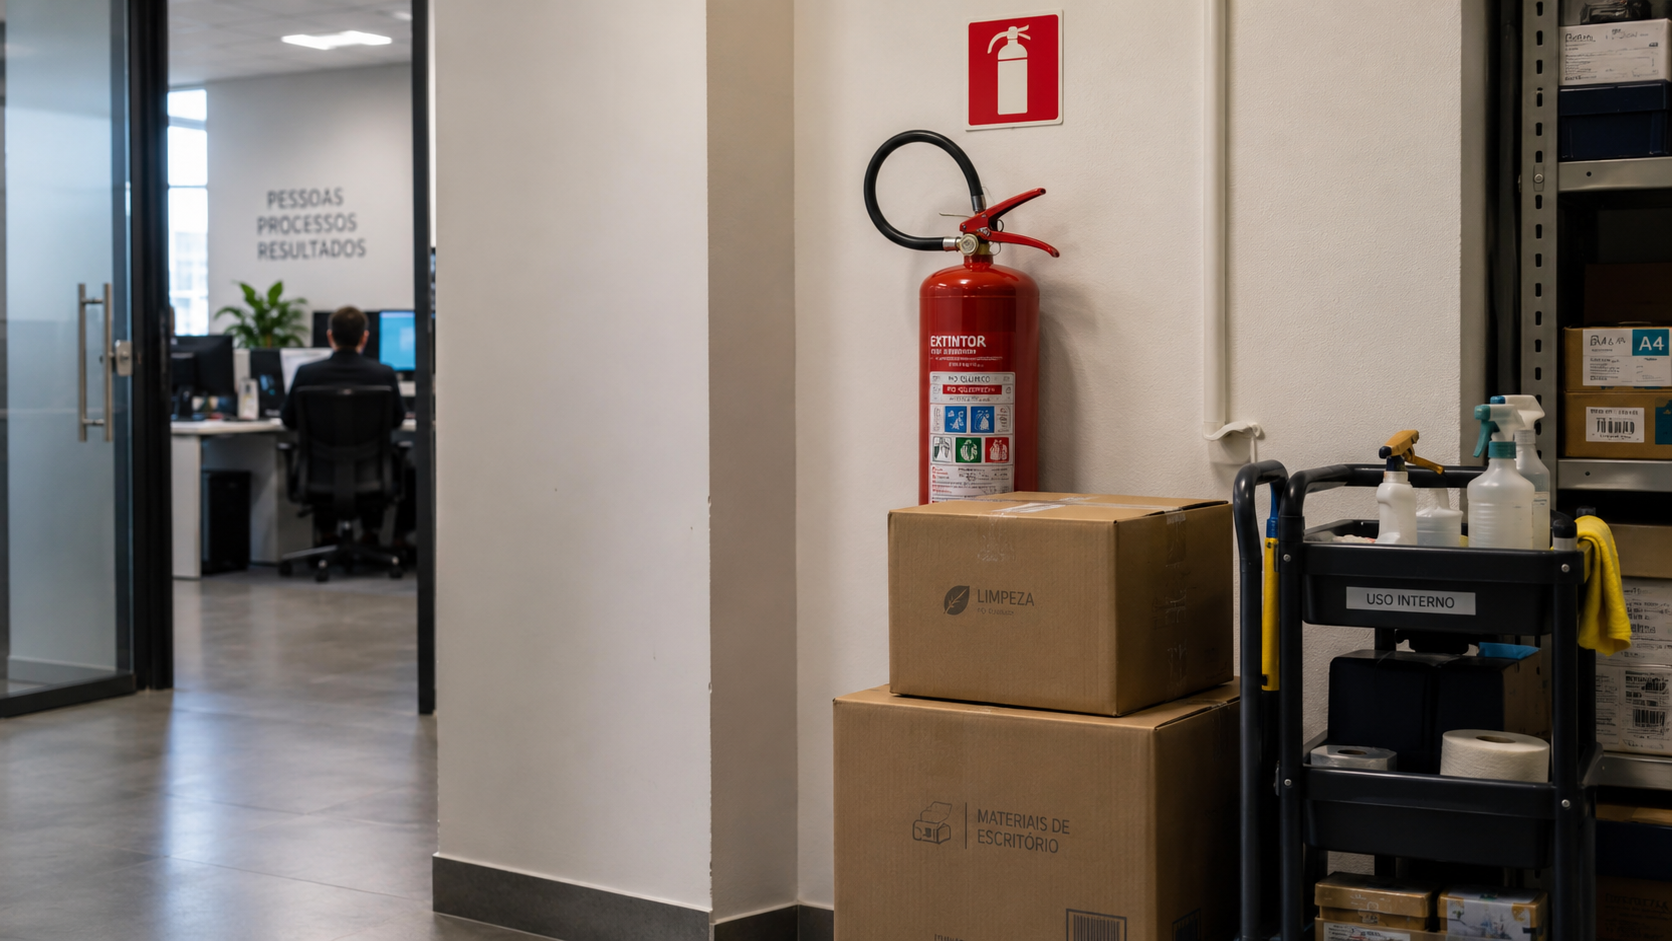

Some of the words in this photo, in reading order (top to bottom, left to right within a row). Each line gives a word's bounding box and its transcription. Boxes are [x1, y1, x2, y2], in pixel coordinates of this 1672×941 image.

[267, 187, 344, 209] PESSOAS
[257, 212, 357, 235] PROCESSOS
[257, 238, 366, 260] RESULTADOS
[930, 335, 986, 348] EXTINTOR
[1639, 336, 1665, 351] A4
[977, 589, 1035, 606] LIMPEZA
[1366, 592, 1394, 606] USO
[1398, 594, 1455, 609] INTERNO
[977, 808, 1048, 832] MATERIAIS
[1052, 818, 1071, 835] DE
[977, 828, 1059, 854] ESCRITÓRIO
